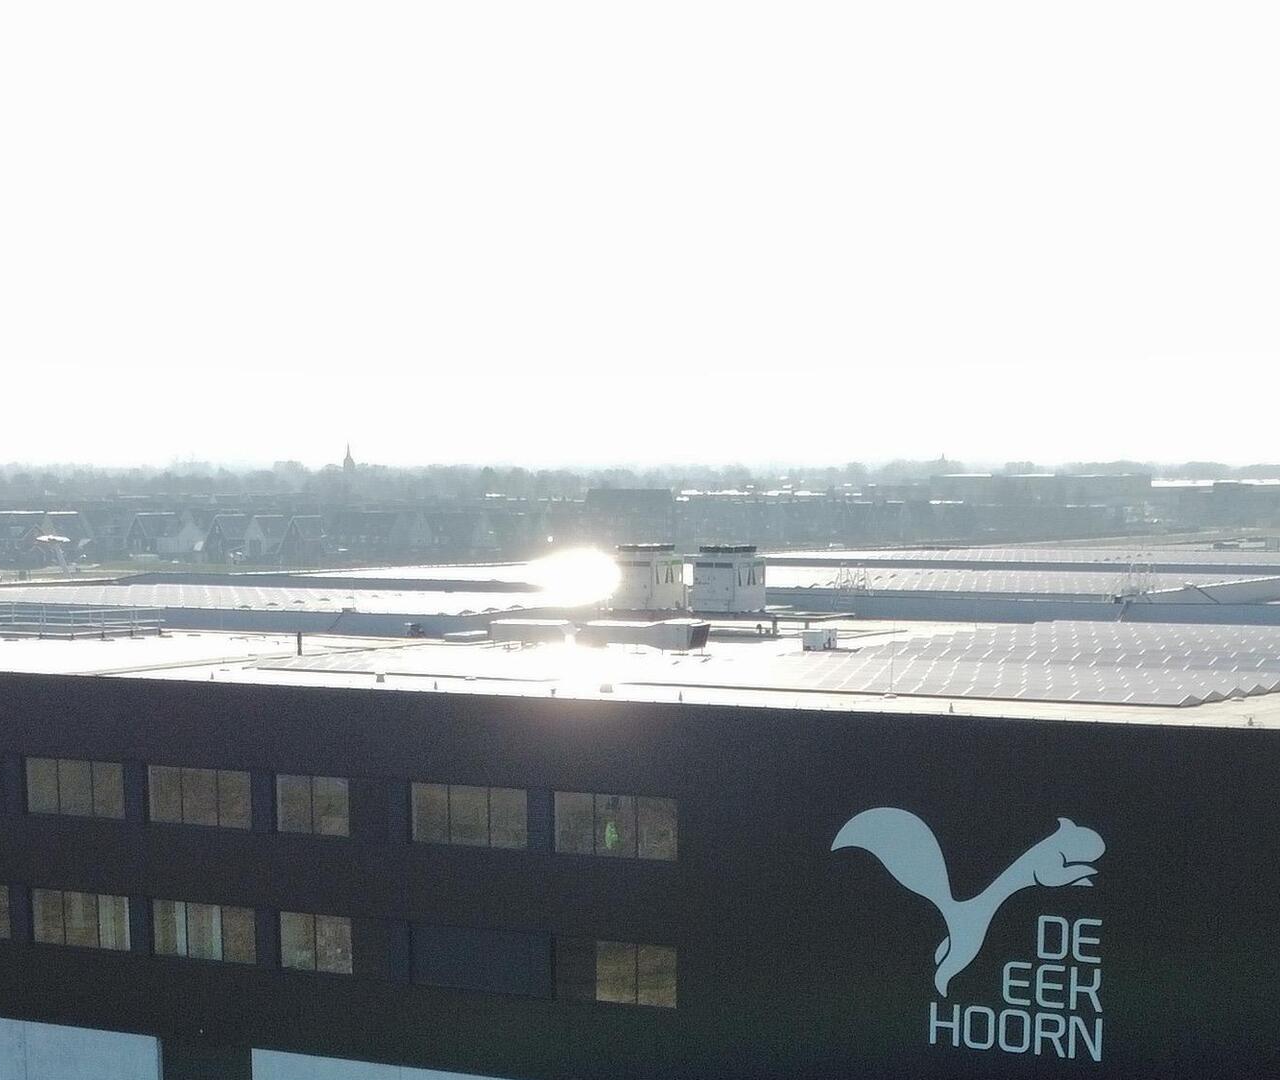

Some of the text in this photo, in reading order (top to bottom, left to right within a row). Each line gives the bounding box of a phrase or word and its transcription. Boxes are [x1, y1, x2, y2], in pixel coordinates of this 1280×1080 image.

[1037, 915, 1103, 963] DE
[1003, 961, 1103, 1013] EEK
[930, 1002, 1103, 1062] HOORN
